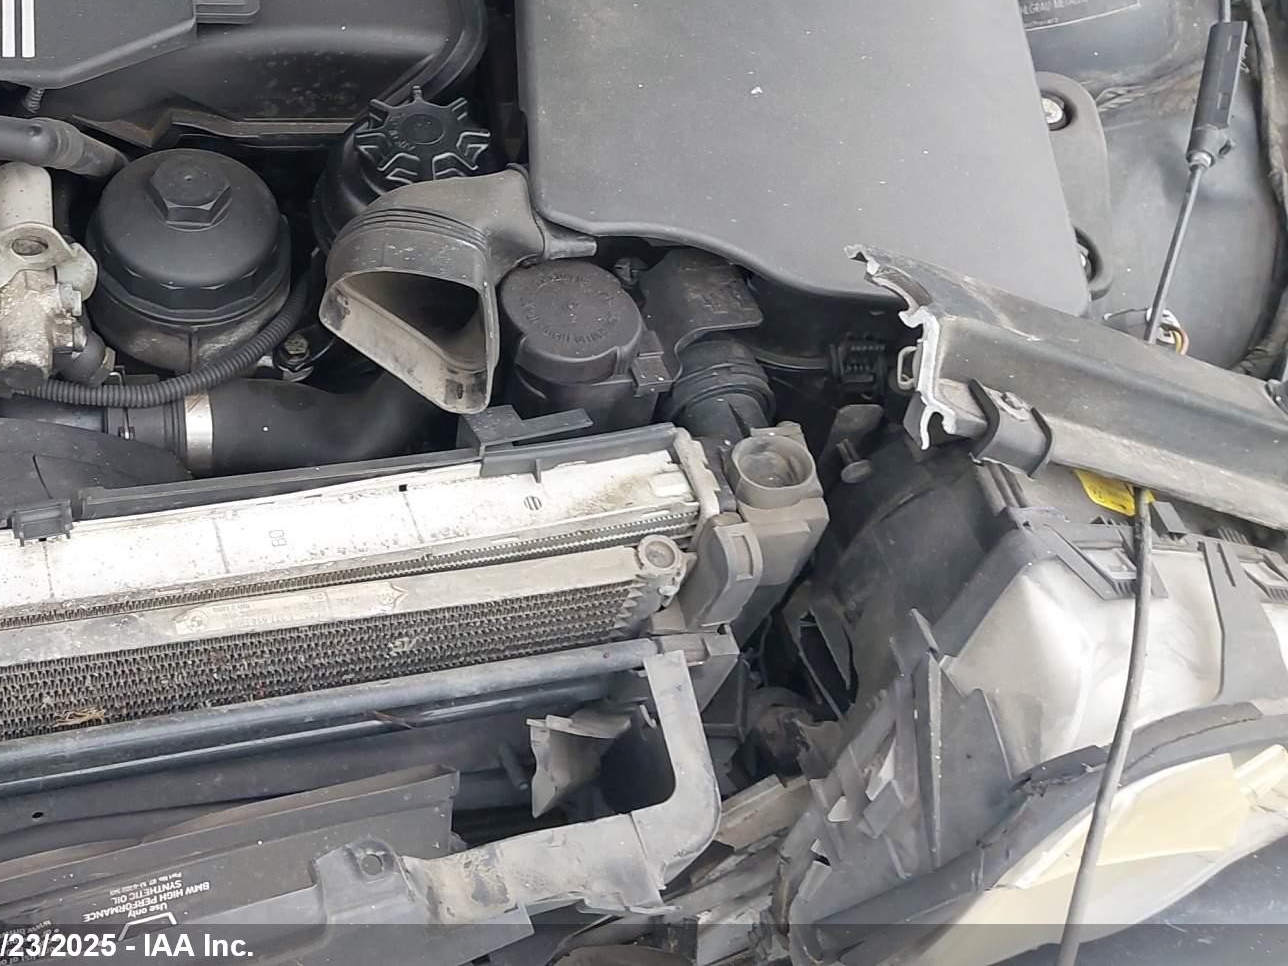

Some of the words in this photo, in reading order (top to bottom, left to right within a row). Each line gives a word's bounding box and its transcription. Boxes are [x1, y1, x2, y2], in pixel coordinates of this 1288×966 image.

[128, 879, 183, 901] SYNTHETIC
[158, 888, 184, 902] HIGH
[184, 881, 210, 895] BMW
[110, 894, 128, 905] OIL
[82, 893, 158, 923] PERFORMANCE
[127, 906, 148, 919] only
[149, 901, 168, 913] Use
